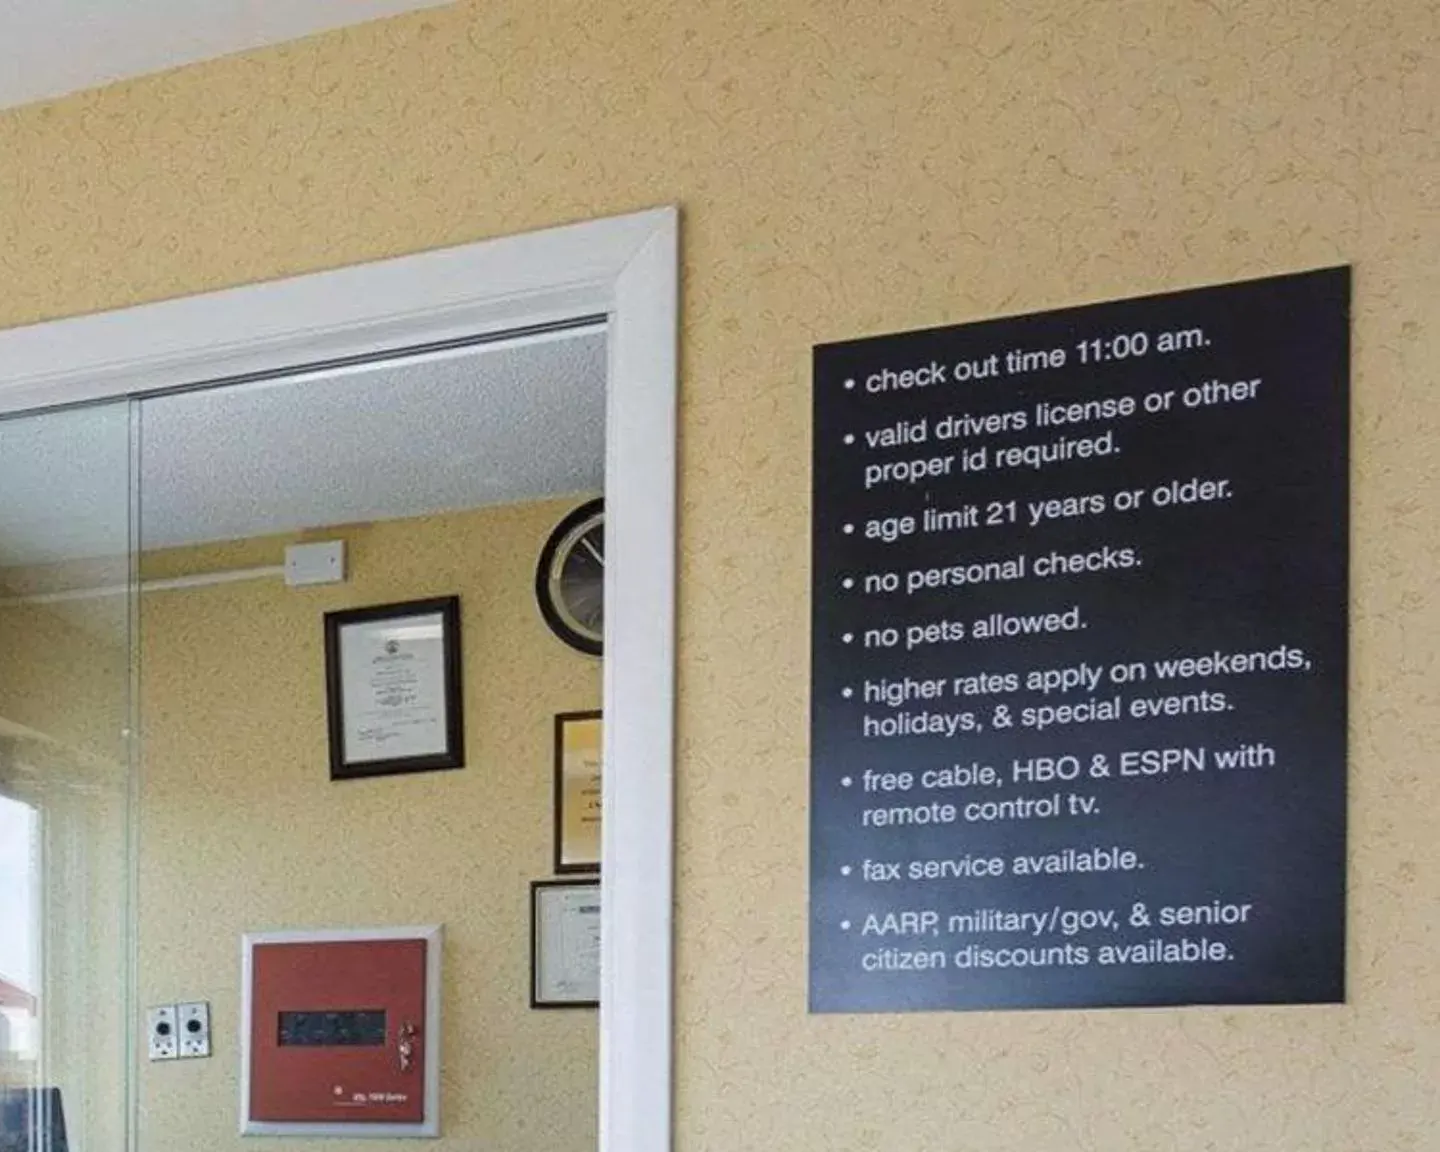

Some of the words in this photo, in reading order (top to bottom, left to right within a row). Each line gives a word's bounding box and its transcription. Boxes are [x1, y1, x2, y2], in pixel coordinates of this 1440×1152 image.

[865, 361, 946, 393] check
[953, 354, 999, 381] out
[1006, 348, 1066, 374] time
[1076, 332, 1149, 363] 11:00
[1156, 328, 1211, 352] am.
[865, 419, 927, 448] valid
[935, 411, 1028, 440] drivers
[1036, 396, 1136, 426] license
[1143, 390, 1175, 413] or
[1183, 379, 1261, 407] other
[865, 456, 955, 489] proper
[962, 447, 986, 472] id
[996, 430, 1120, 469] required.
[864, 516, 916, 543] age
[923, 505, 979, 532] limit
[986, 500, 1016, 525] 21
[1028, 494, 1106, 526] years
[1114, 490, 1145, 511] or
[1152, 478, 1232, 506] older.
[865, 573, 899, 593] no
[907, 555, 1025, 595] personal
[1033, 546, 1142, 576] checks.
[864, 628, 899, 648] no
[907, 620, 965, 650] pets
[972, 606, 1087, 639] allowed.
[864, 677, 947, 707] higher
[954, 672, 1019, 695] rates
[1026, 662, 1103, 694] apply
[1109, 662, 1146, 683] on
[1154, 645, 1311, 679] weekends,
[863, 711, 982, 737] holidays,
[992, 704, 1013, 729] &
[1021, 696, 1121, 731] special
[1130, 690, 1234, 718] events.
[862, 769, 914, 792] free
[921, 762, 1003, 789] cable,
[1012, 755, 1080, 783] HBO
[1089, 753, 1111, 778] &
[1120, 747, 1205, 776] ESPN
[1214, 743, 1275, 769] with
[862, 802, 957, 827] remote
[964, 793, 1060, 822] control
[1068, 793, 1100, 815] tv.
[862, 859, 901, 881] fax
[908, 855, 1004, 880] service
[1012, 846, 1144, 875] available.
[1129, 902, 1151, 927] &
[1159, 900, 1252, 926] senior
[861, 947, 946, 972] citizen
[954, 943, 1089, 969] discounts
[1097, 938, 1234, 965] available.
